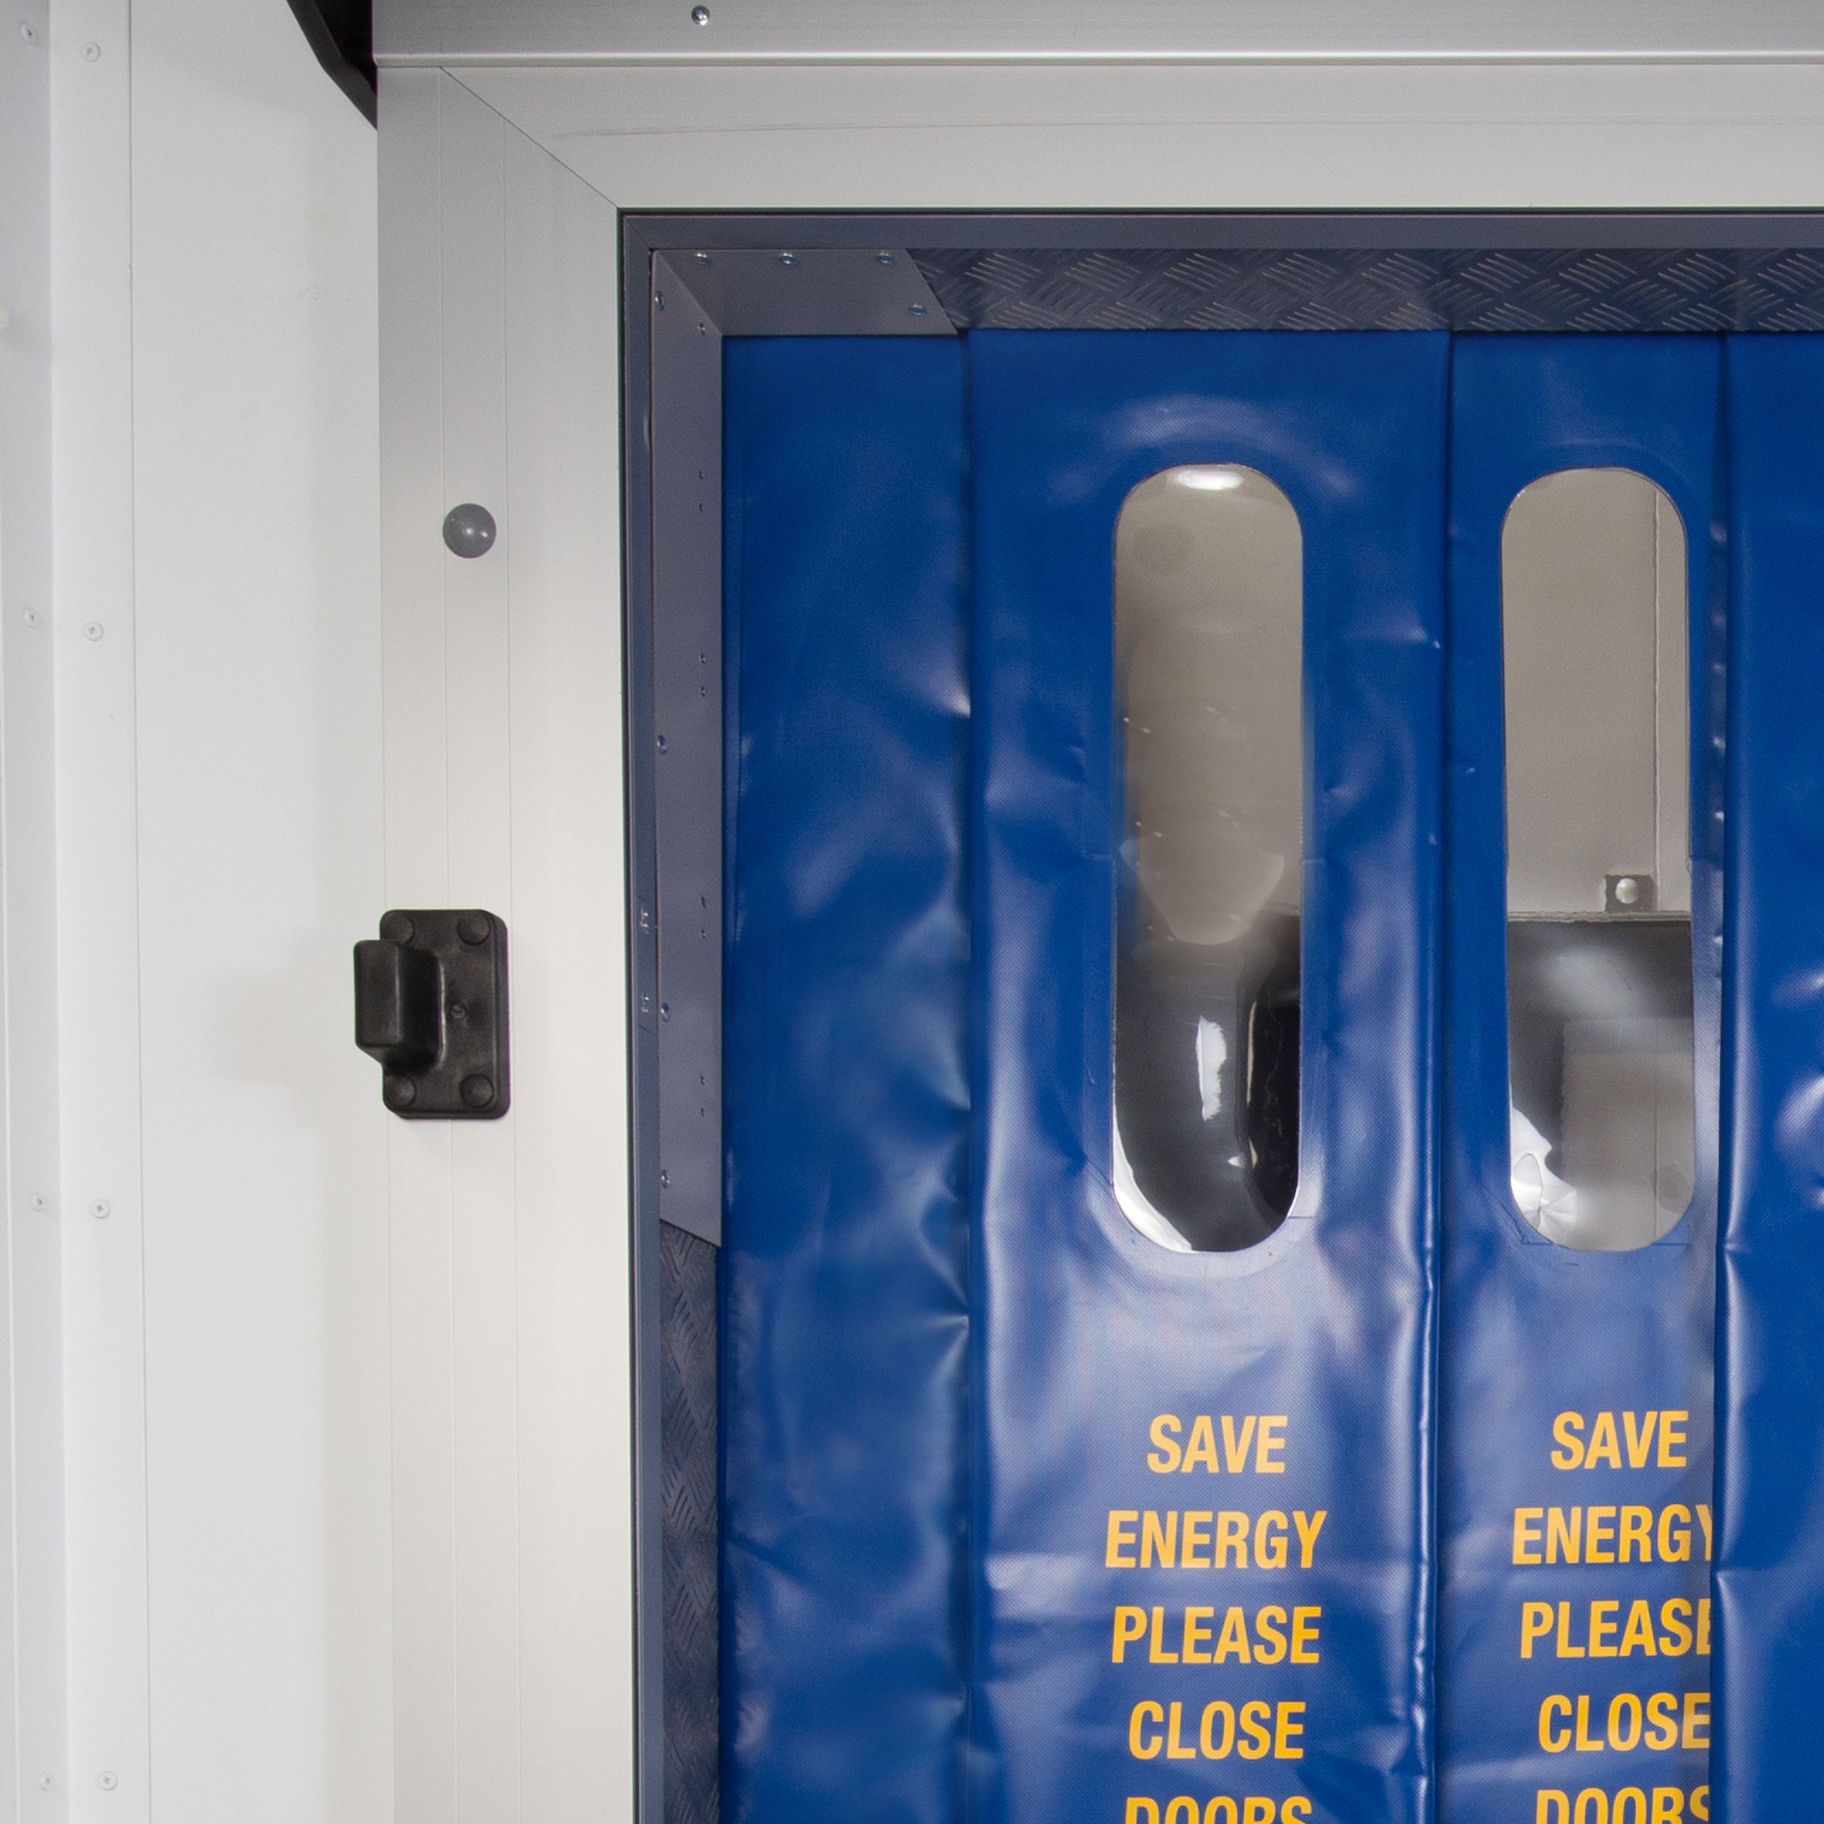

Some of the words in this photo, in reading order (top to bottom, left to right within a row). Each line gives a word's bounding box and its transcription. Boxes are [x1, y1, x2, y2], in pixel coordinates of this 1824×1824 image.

[1147, 1414, 1288, 1473] SAVE
[1551, 1411, 1689, 1470] SAVE
[1105, 1510, 1327, 1569] ENERGY
[1111, 1605, 1322, 1665] PLEASE
[1128, 1700, 1306, 1760] CLOSE
[1538, 1693, 1711, 1753] CLOSE
